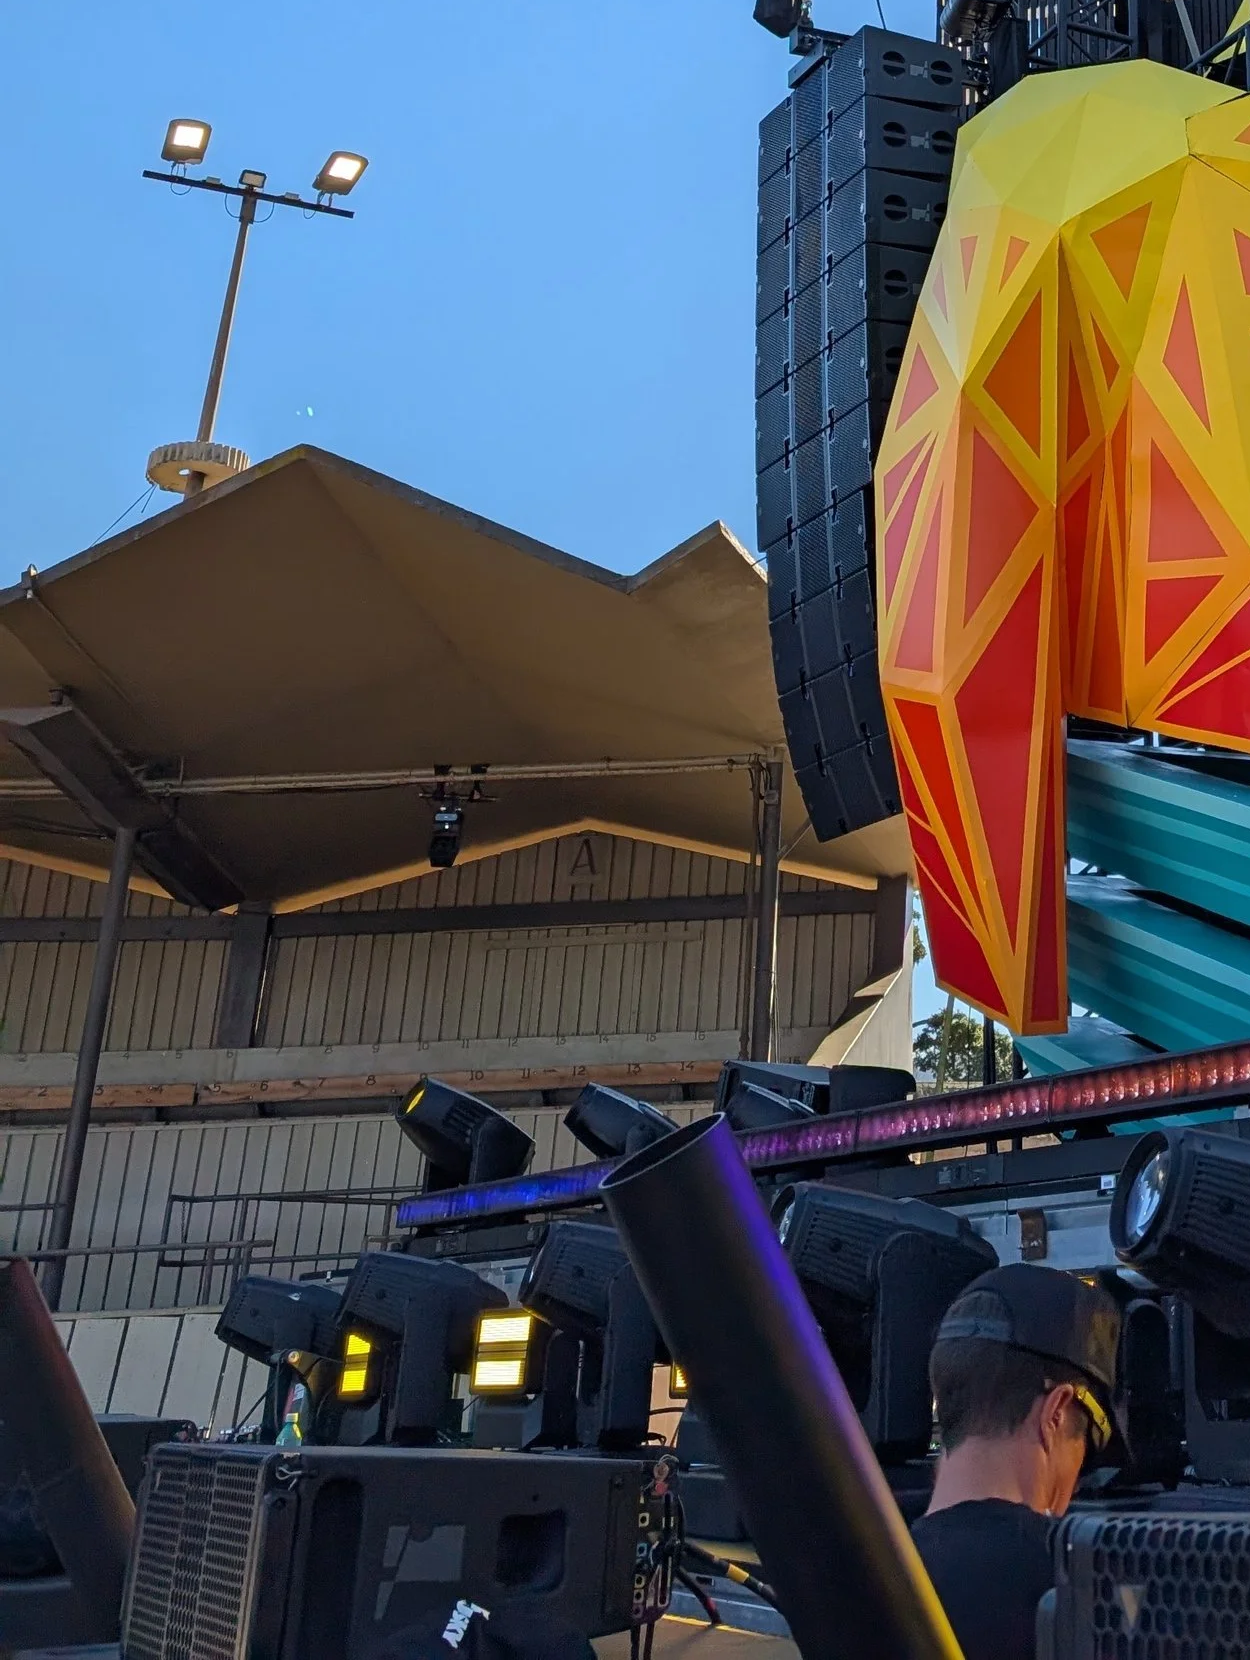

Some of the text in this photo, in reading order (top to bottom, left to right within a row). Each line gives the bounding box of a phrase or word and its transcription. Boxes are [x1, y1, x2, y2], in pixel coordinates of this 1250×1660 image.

[569, 838, 597, 877] A
[37, 1085, 47, 1097] 2
[94, 1084, 104, 1096] 3
[260, 1080, 269, 1091] 6
[317, 1076, 327, 1088] 7
[366, 1075, 377, 1086] 8
[469, 1070, 484, 1082] 10
[521, 1068, 531, 1079] 11
[572, 1065, 586, 1077] 12
[626, 1063, 642, 1075] 13
[680, 1061, 695, 1072] 14
